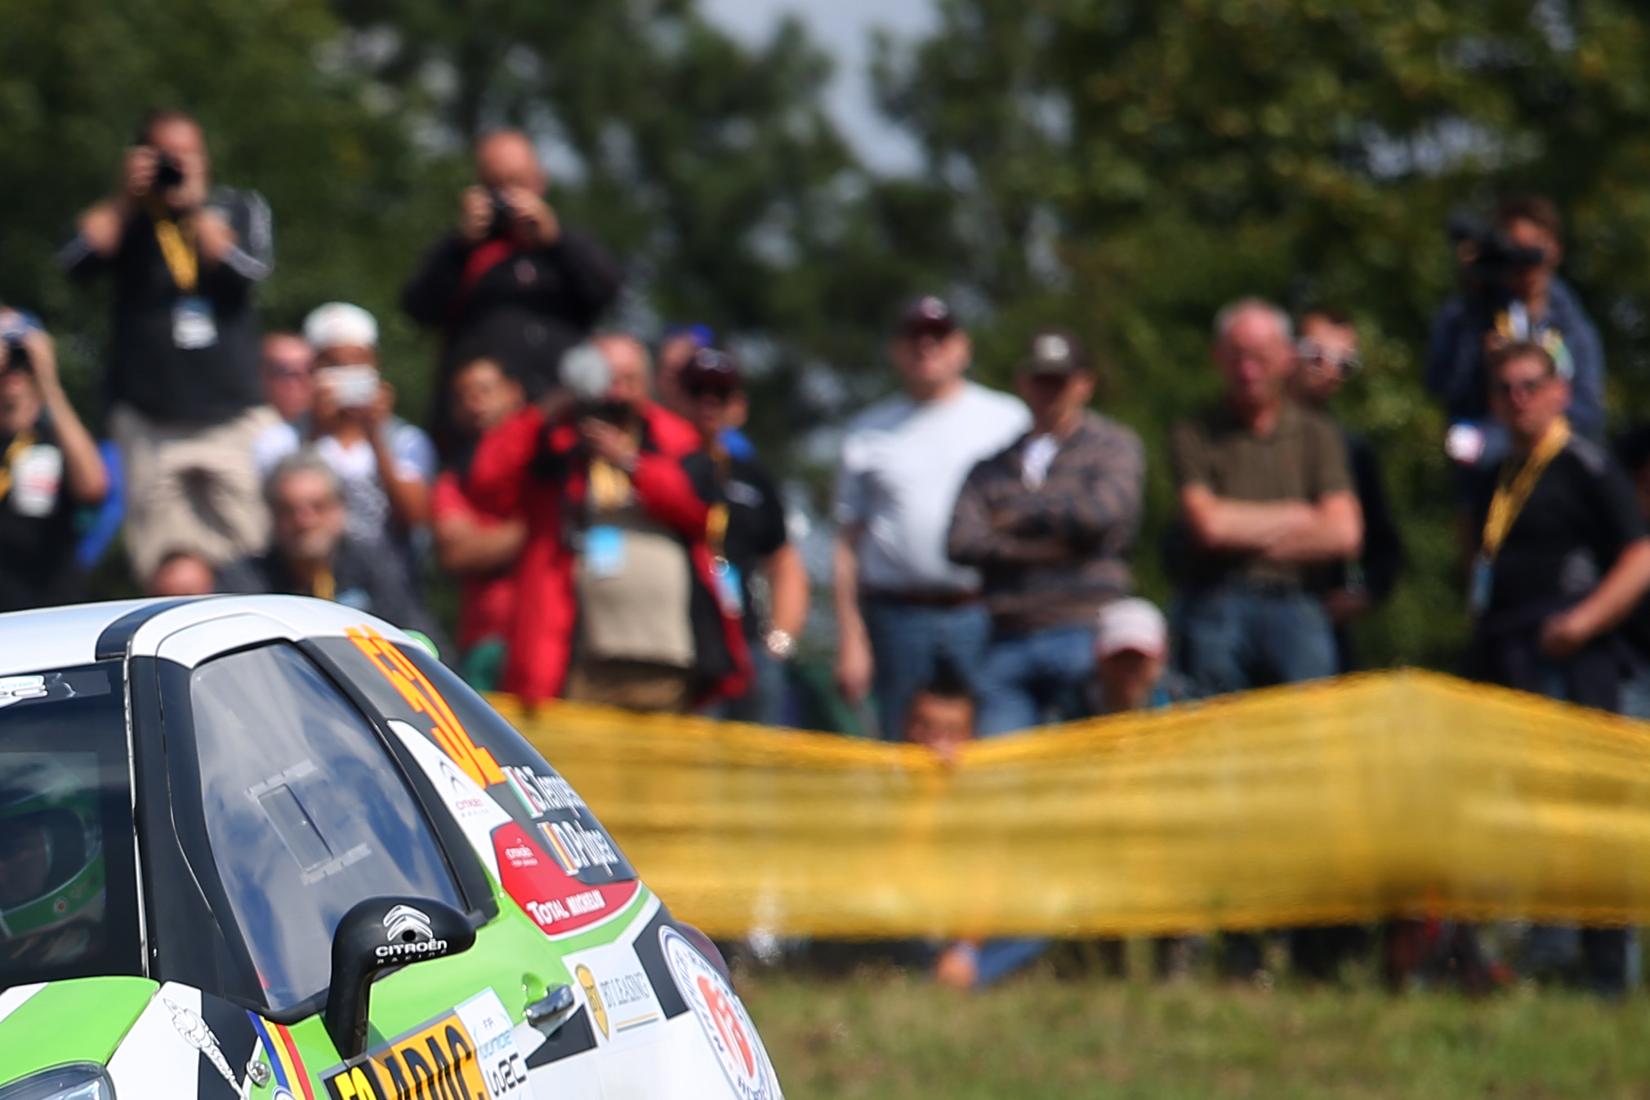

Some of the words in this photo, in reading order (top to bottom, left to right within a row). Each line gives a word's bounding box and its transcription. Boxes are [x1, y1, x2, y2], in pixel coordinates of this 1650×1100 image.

[343, 624, 507, 789] 52
[526, 900, 570, 926] TOTAL
[375, 938, 448, 957] CITROËN
